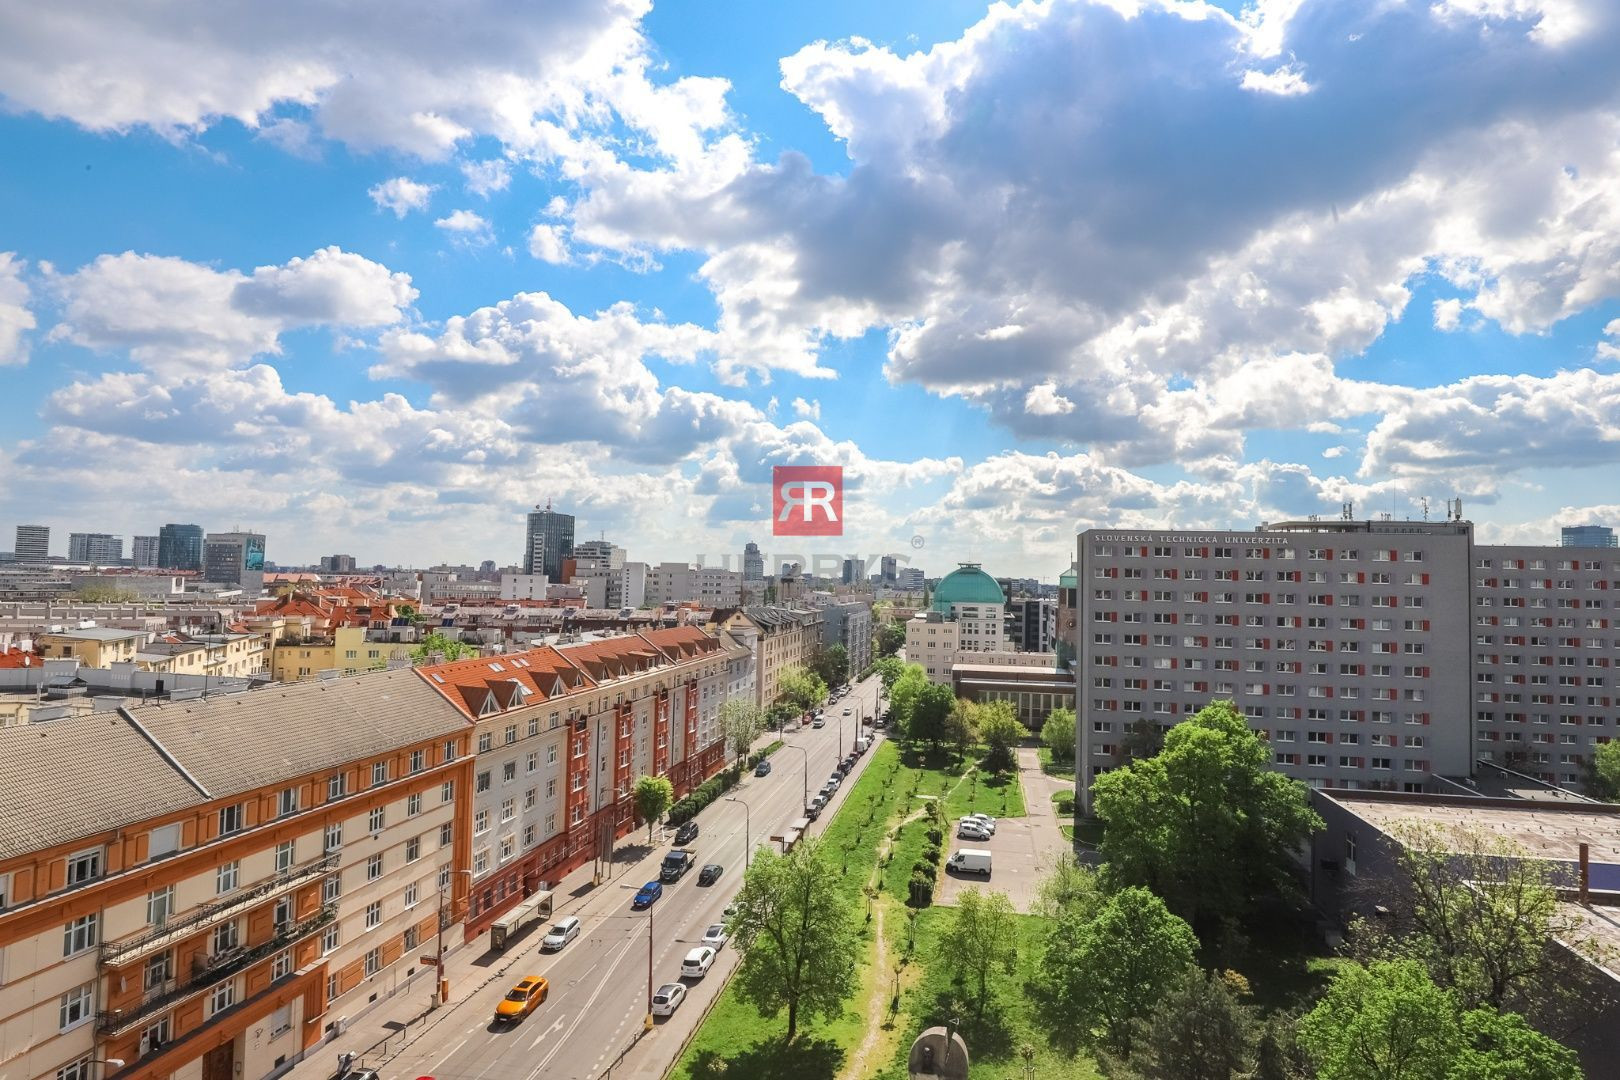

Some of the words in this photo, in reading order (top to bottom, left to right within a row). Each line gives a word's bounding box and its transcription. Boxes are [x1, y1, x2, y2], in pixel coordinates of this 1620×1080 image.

[1095, 534, 1153, 542] SLOVENSKÁ
[1159, 535, 1218, 543] TECHNICKÁ
[1224, 536, 1289, 545] UNIVERZITA
